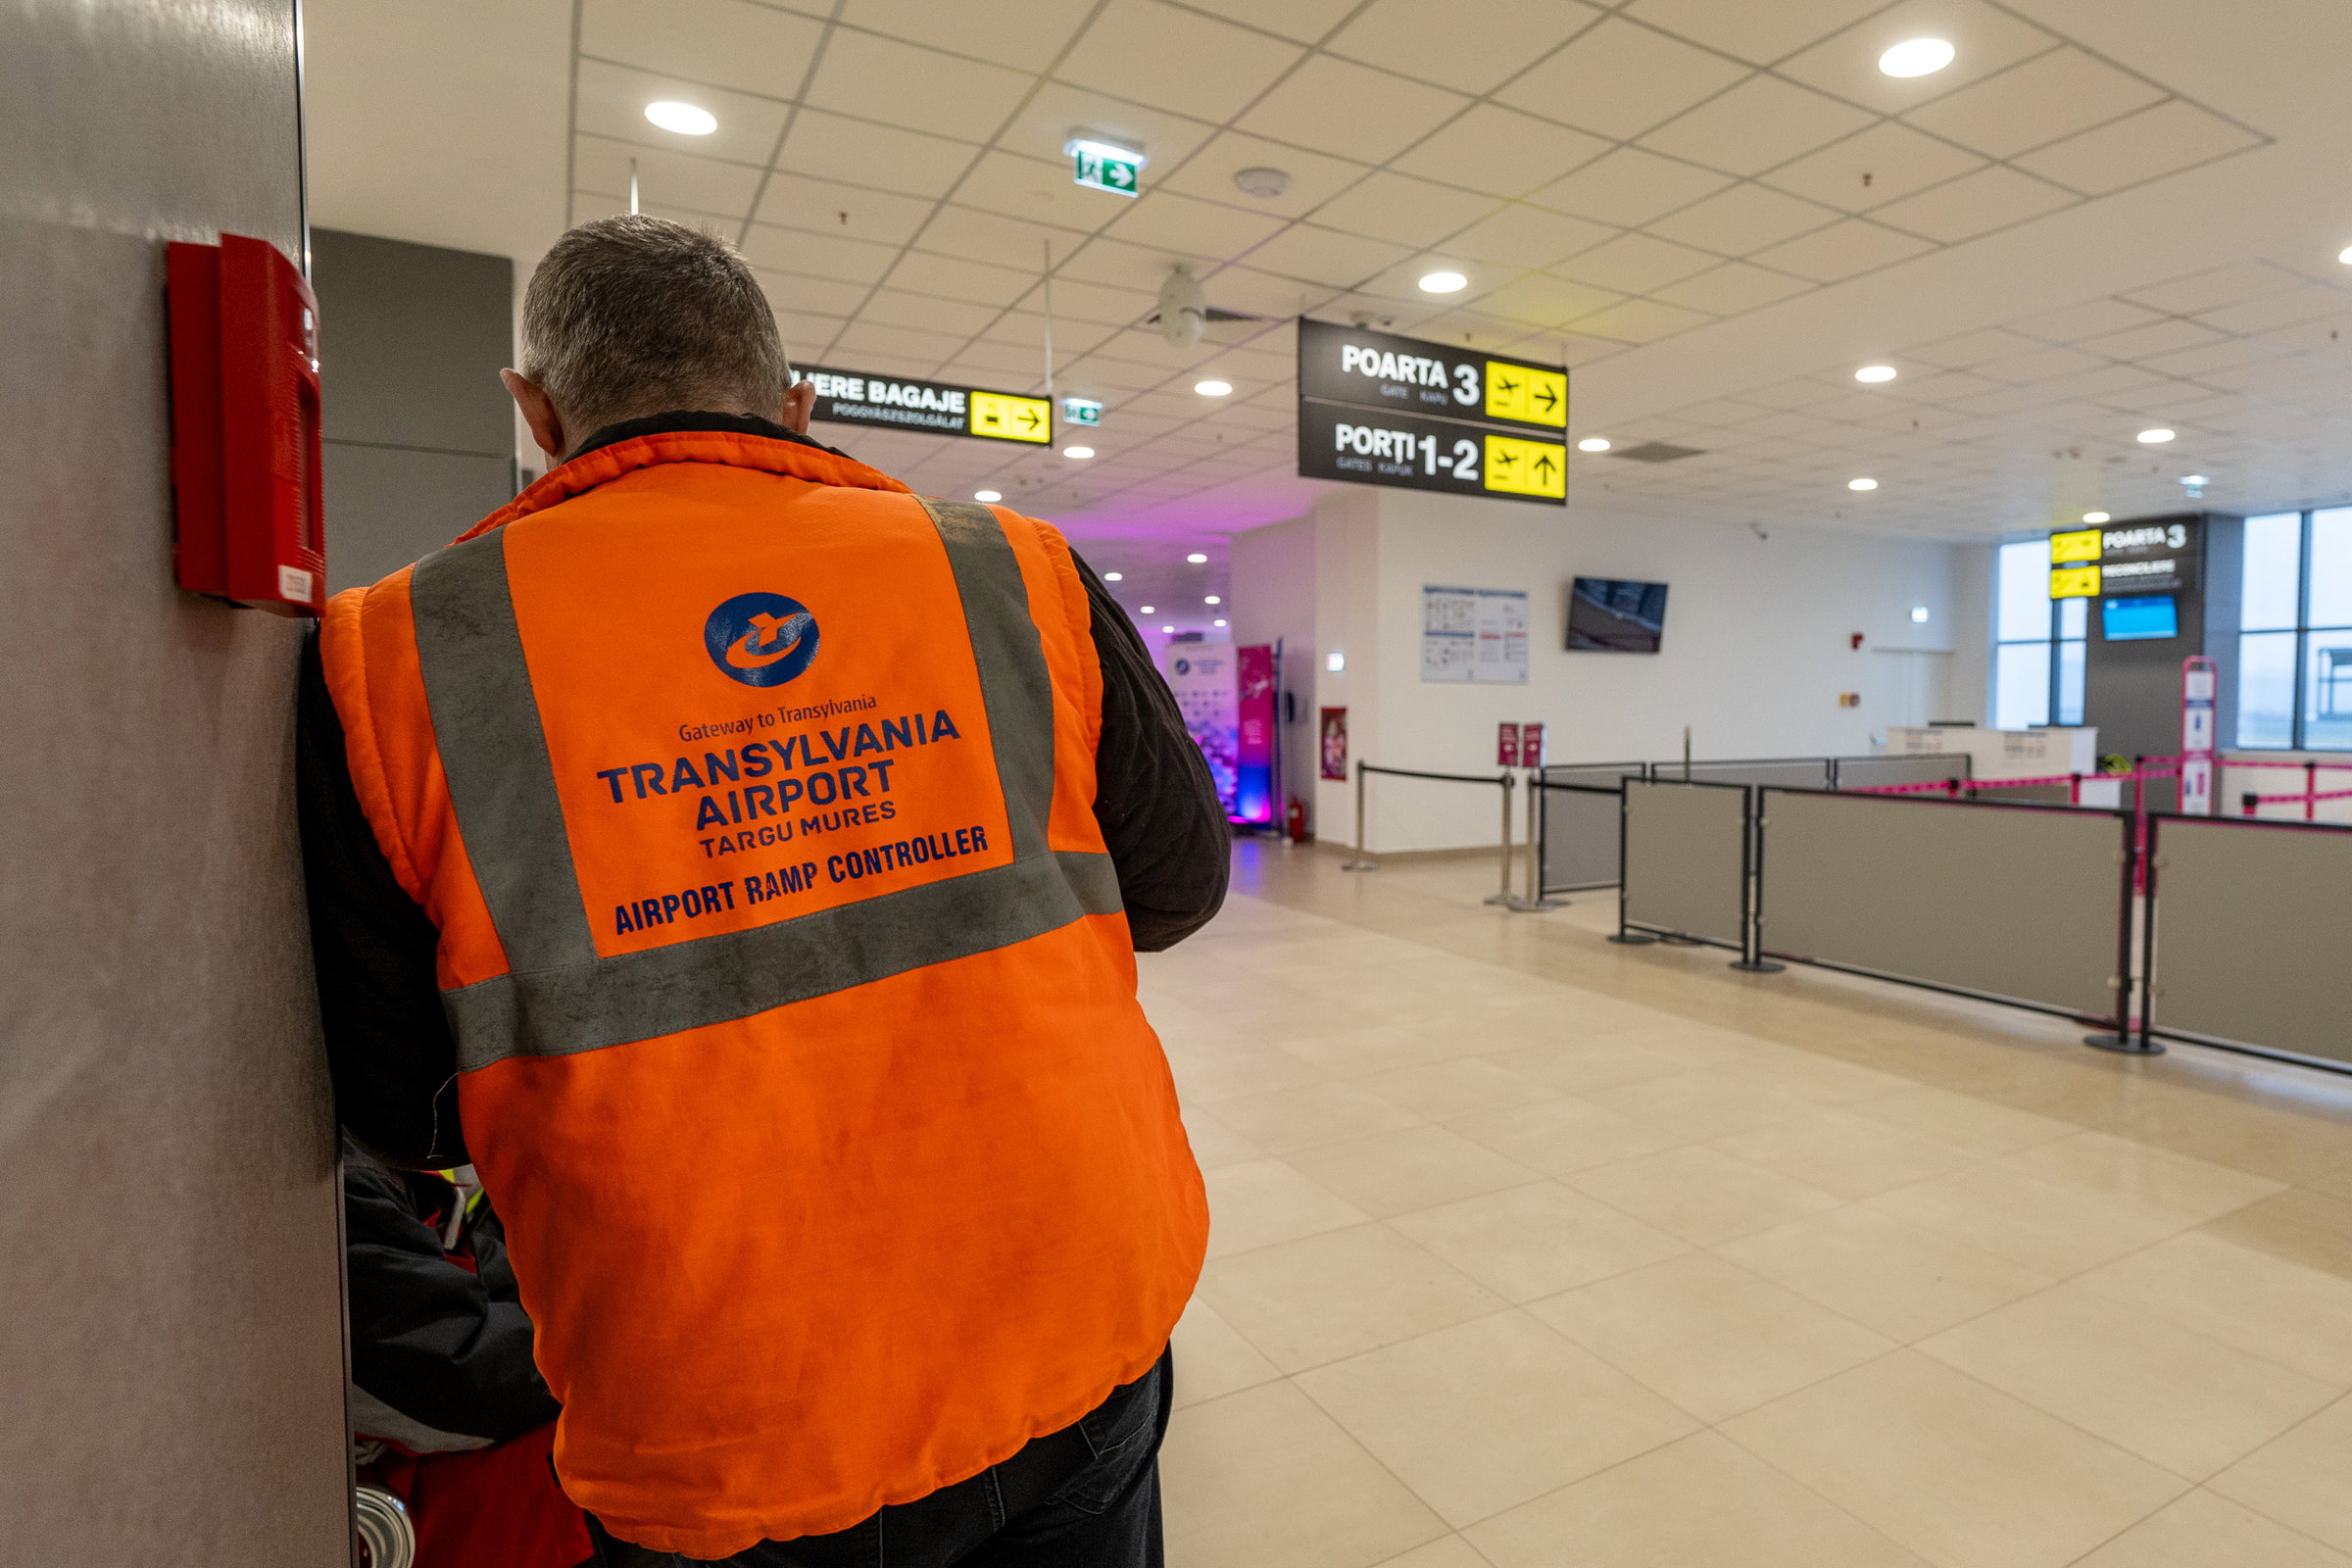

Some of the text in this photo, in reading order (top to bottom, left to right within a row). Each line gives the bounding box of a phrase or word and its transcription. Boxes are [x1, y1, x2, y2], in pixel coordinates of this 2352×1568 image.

[868, 380, 965, 414] BAGAJE
[1341, 344, 1481, 407] POARTA 3
[1418, 434, 1479, 480] 1-2
[2102, 523, 2187, 550] POARTA 3
[679, 694, 877, 743] Gateway to Transylvania
[597, 710, 961, 804] TRANSYLVANIA
[696, 759, 896, 831] AIRPORT
[699, 801, 897, 858] TARGU MURES
[614, 825, 989, 935] AIRPORT RAMP CONTROLLER
